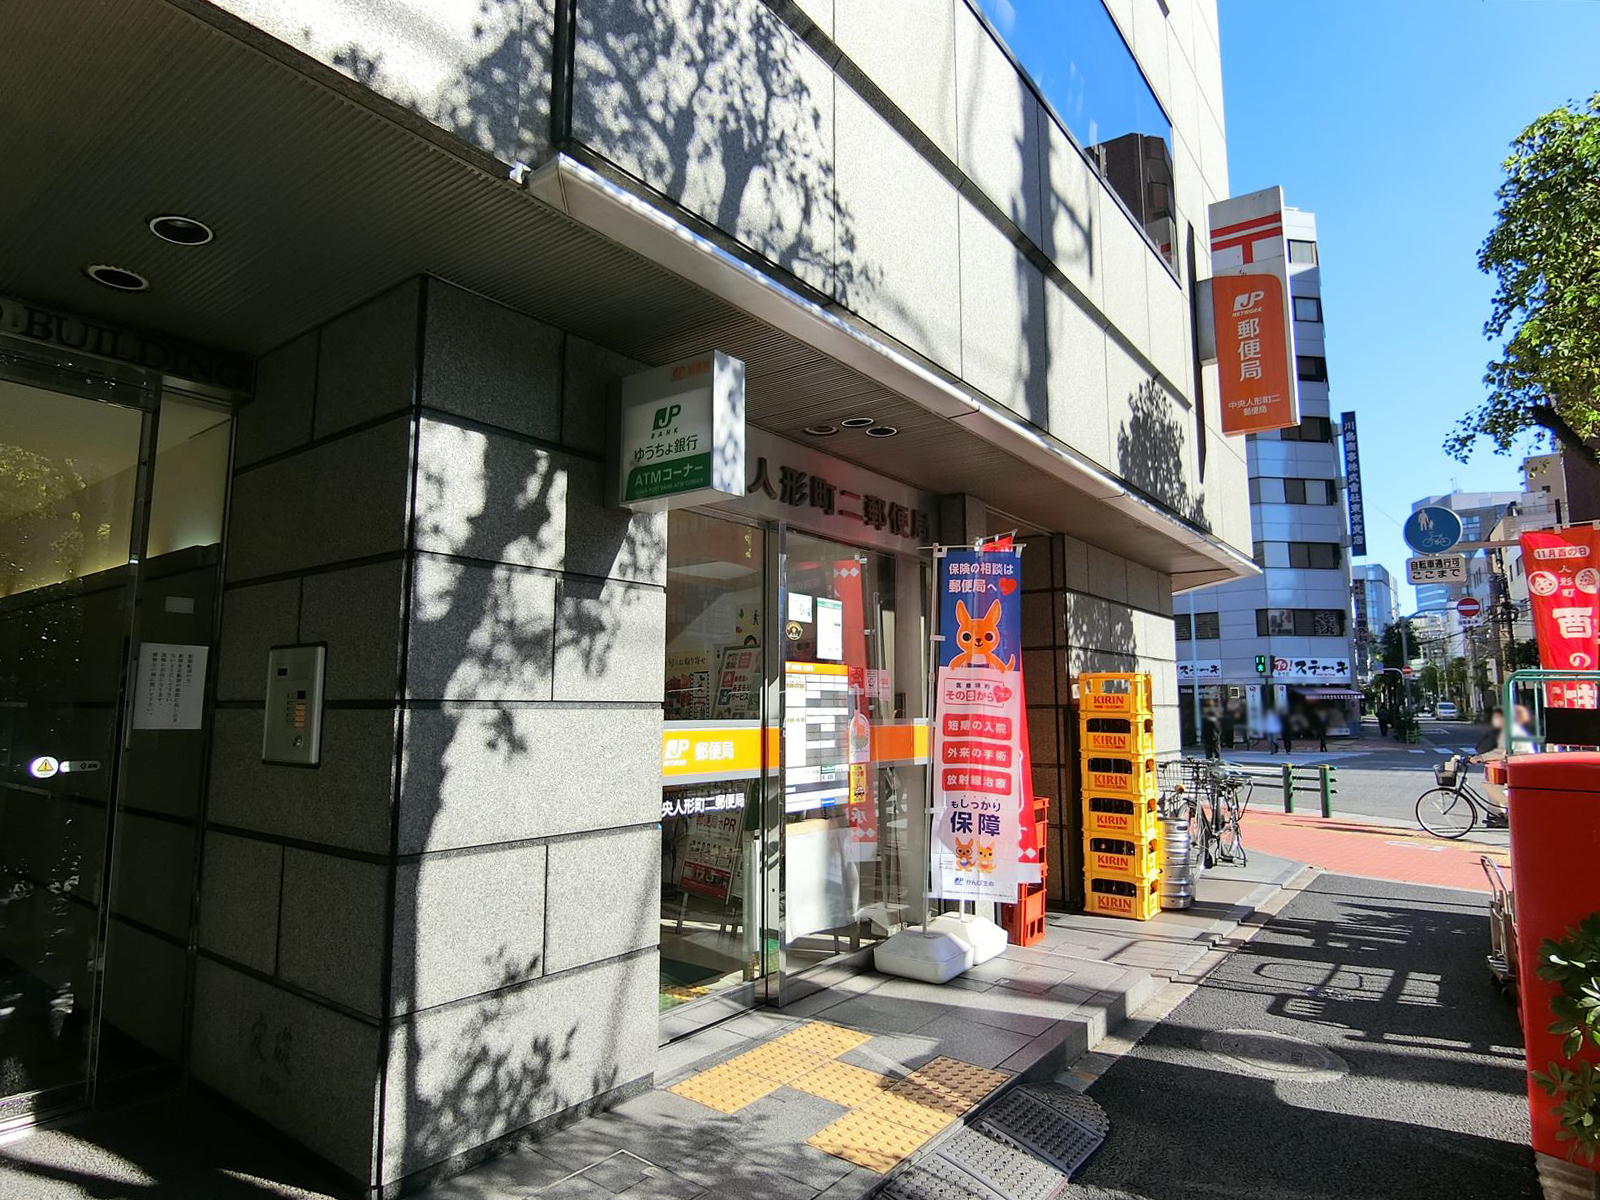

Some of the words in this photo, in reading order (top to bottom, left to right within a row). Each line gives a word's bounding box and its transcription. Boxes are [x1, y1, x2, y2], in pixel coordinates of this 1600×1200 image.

[1233, 291, 1264, 311] JP
[1232, 307, 1263, 318] NETWORK
[30, 308, 244, 388] BUILDING
[1238, 317, 1262, 382] 郵便局
[1228, 394, 1280, 409] 中央人形町二
[653, 404, 681, 430] JP
[1244, 405, 1267, 416] 郵便局
[651, 427, 678, 439] BANK
[634, 434, 698, 463] ゆうちょ銀行
[634, 463, 703, 488] ATMコーナー
[747, 457, 931, 544] 人形町二郵便局
[1536, 547, 1587, 558] 11月酉の日
[949, 562, 1014, 575] 保険の相談は
[1410, 558, 1460, 571] 自転車通行可
[1412, 568, 1461, 580] ここまで
[948, 579, 998, 593] 郵便局へ
[1559, 565, 1574, 598] 人形町
[945, 690, 995, 703] その日から
[1093, 695, 1124, 705] KIRIN
[948, 720, 1007, 735] 短期の入院
[1093, 735, 1126, 746] KIRIN
[695, 741, 734, 761] 郵便局
[948, 747, 1007, 762] 外来の手術
[946, 775, 1006, 789] 放射線治療
[1094, 775, 1127, 786] KIRIN
[661, 793, 745, 818] 央人形町二郵便局
[951, 799, 1001, 813] もしっかり
[950, 811, 1001, 837] 保障
[1097, 815, 1128, 826] KIRIN
[1098, 855, 1129, 867] KIRIN
[1098, 895, 1132, 908] KIRIN
